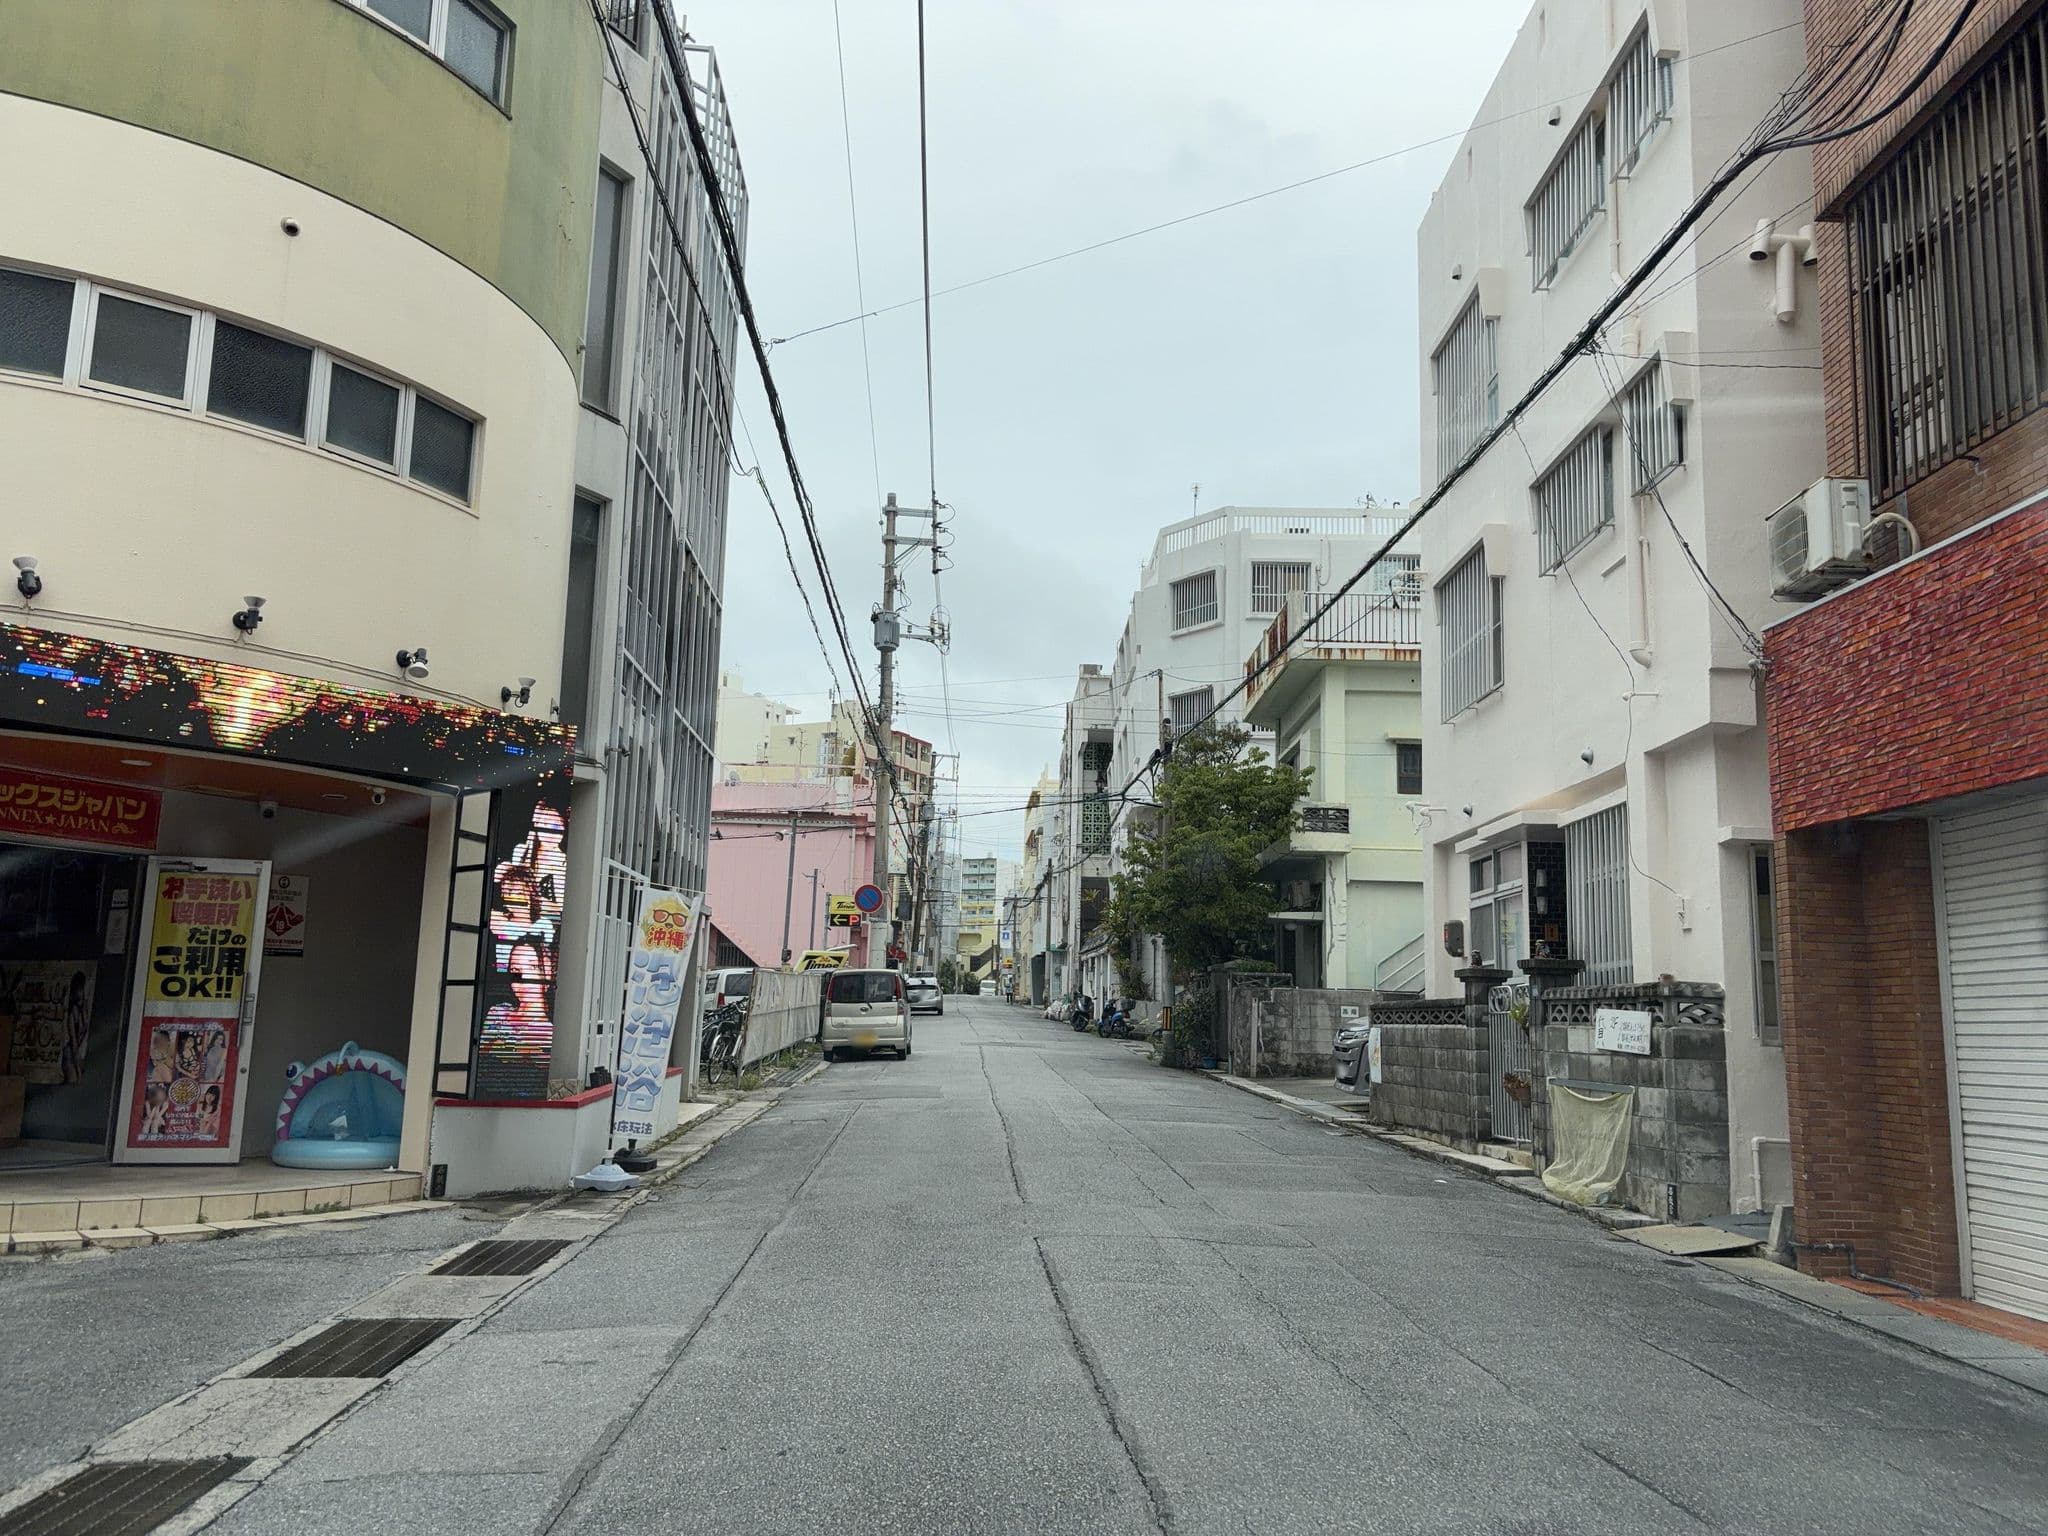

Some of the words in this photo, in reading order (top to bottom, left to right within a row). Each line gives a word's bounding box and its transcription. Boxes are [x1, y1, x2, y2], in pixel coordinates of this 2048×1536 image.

[849, 915, 859, 925] P
[187, 926, 247, 946] だけの
[153, 945, 247, 976] ご利用
[160, 976, 233, 998] OK!!
